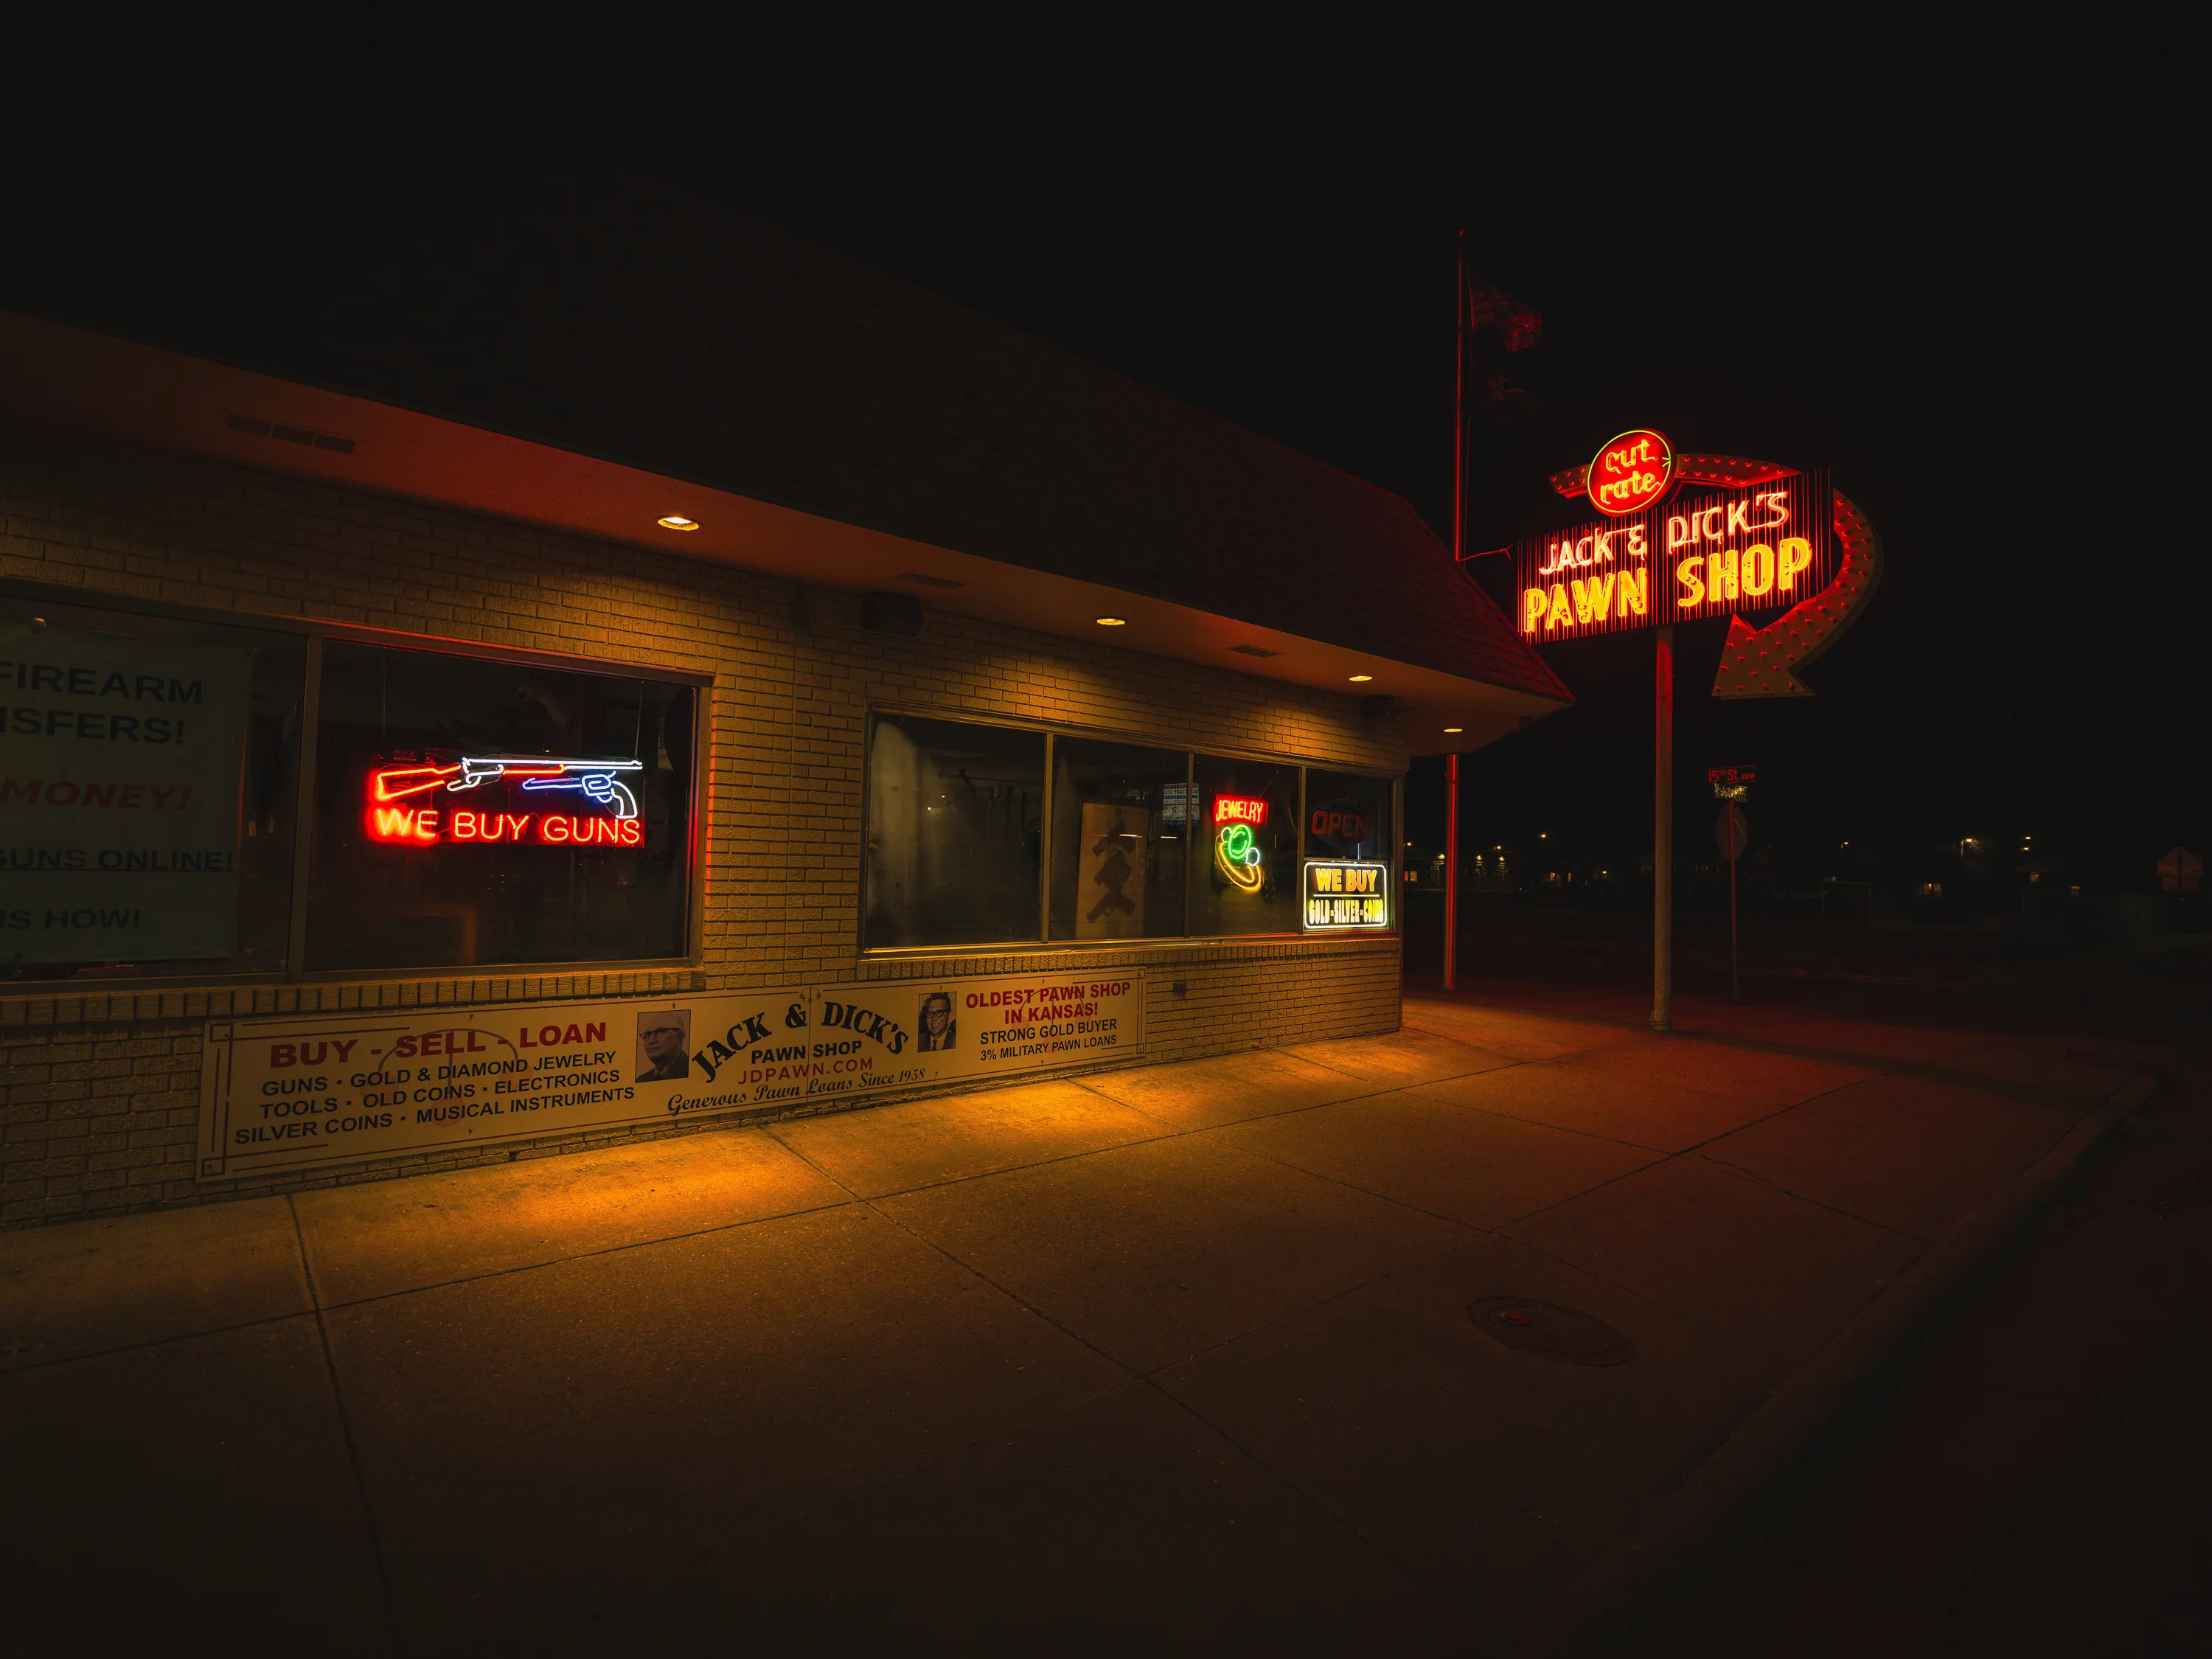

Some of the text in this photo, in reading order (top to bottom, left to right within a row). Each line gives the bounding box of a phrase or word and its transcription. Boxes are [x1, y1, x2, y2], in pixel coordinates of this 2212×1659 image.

[1600, 470, 1661, 504] rate
[1539, 491, 1789, 575] JACK & DICK'S
[1523, 537, 1812, 633] PAWN SHOP
[0, 706, 185, 745] SFERS!
[0, 777, 192, 811] MONEY!
[1215, 799, 1264, 823] JEWELRY
[375, 808, 641, 844] WE BUY GUNS
[1311, 810, 1370, 841] OPEN
[0, 847, 233, 870] UNS ONLINE!
[1315, 868, 1377, 891] WE BUY
[45, 908, 142, 930] HOW!
[966, 981, 1130, 1009] OLDEST PAWN SHOP
[1004, 1001, 1099, 1025] IN KANSAS!
[270, 1039, 359, 1068] BUY
[394, 1031, 486, 1058] SELL
[520, 1022, 606, 1048] LOAN
[691, 1001, 909, 1084] JACK & DICK'S
[980, 1018, 1117, 1045] STRONG GOLD BUYER
[981, 1034, 1117, 1061] 3% MILITARY PAWN LOANS
[751, 1040, 863, 1065] PAWN SHOP
[262, 1051, 616, 1096] GUNS GOLD & DIAMOND JEWELRY
[737, 1057, 873, 1085] JDPAWN.COM
[260, 1069, 620, 1119] TOOLS OLD COINS ELECTRONICS
[667, 1068, 926, 1117] Generous Pawn Loans Since 1958
[234, 1087, 634, 1144] SILVER COINS MUSICAL INSTRUMENTS
